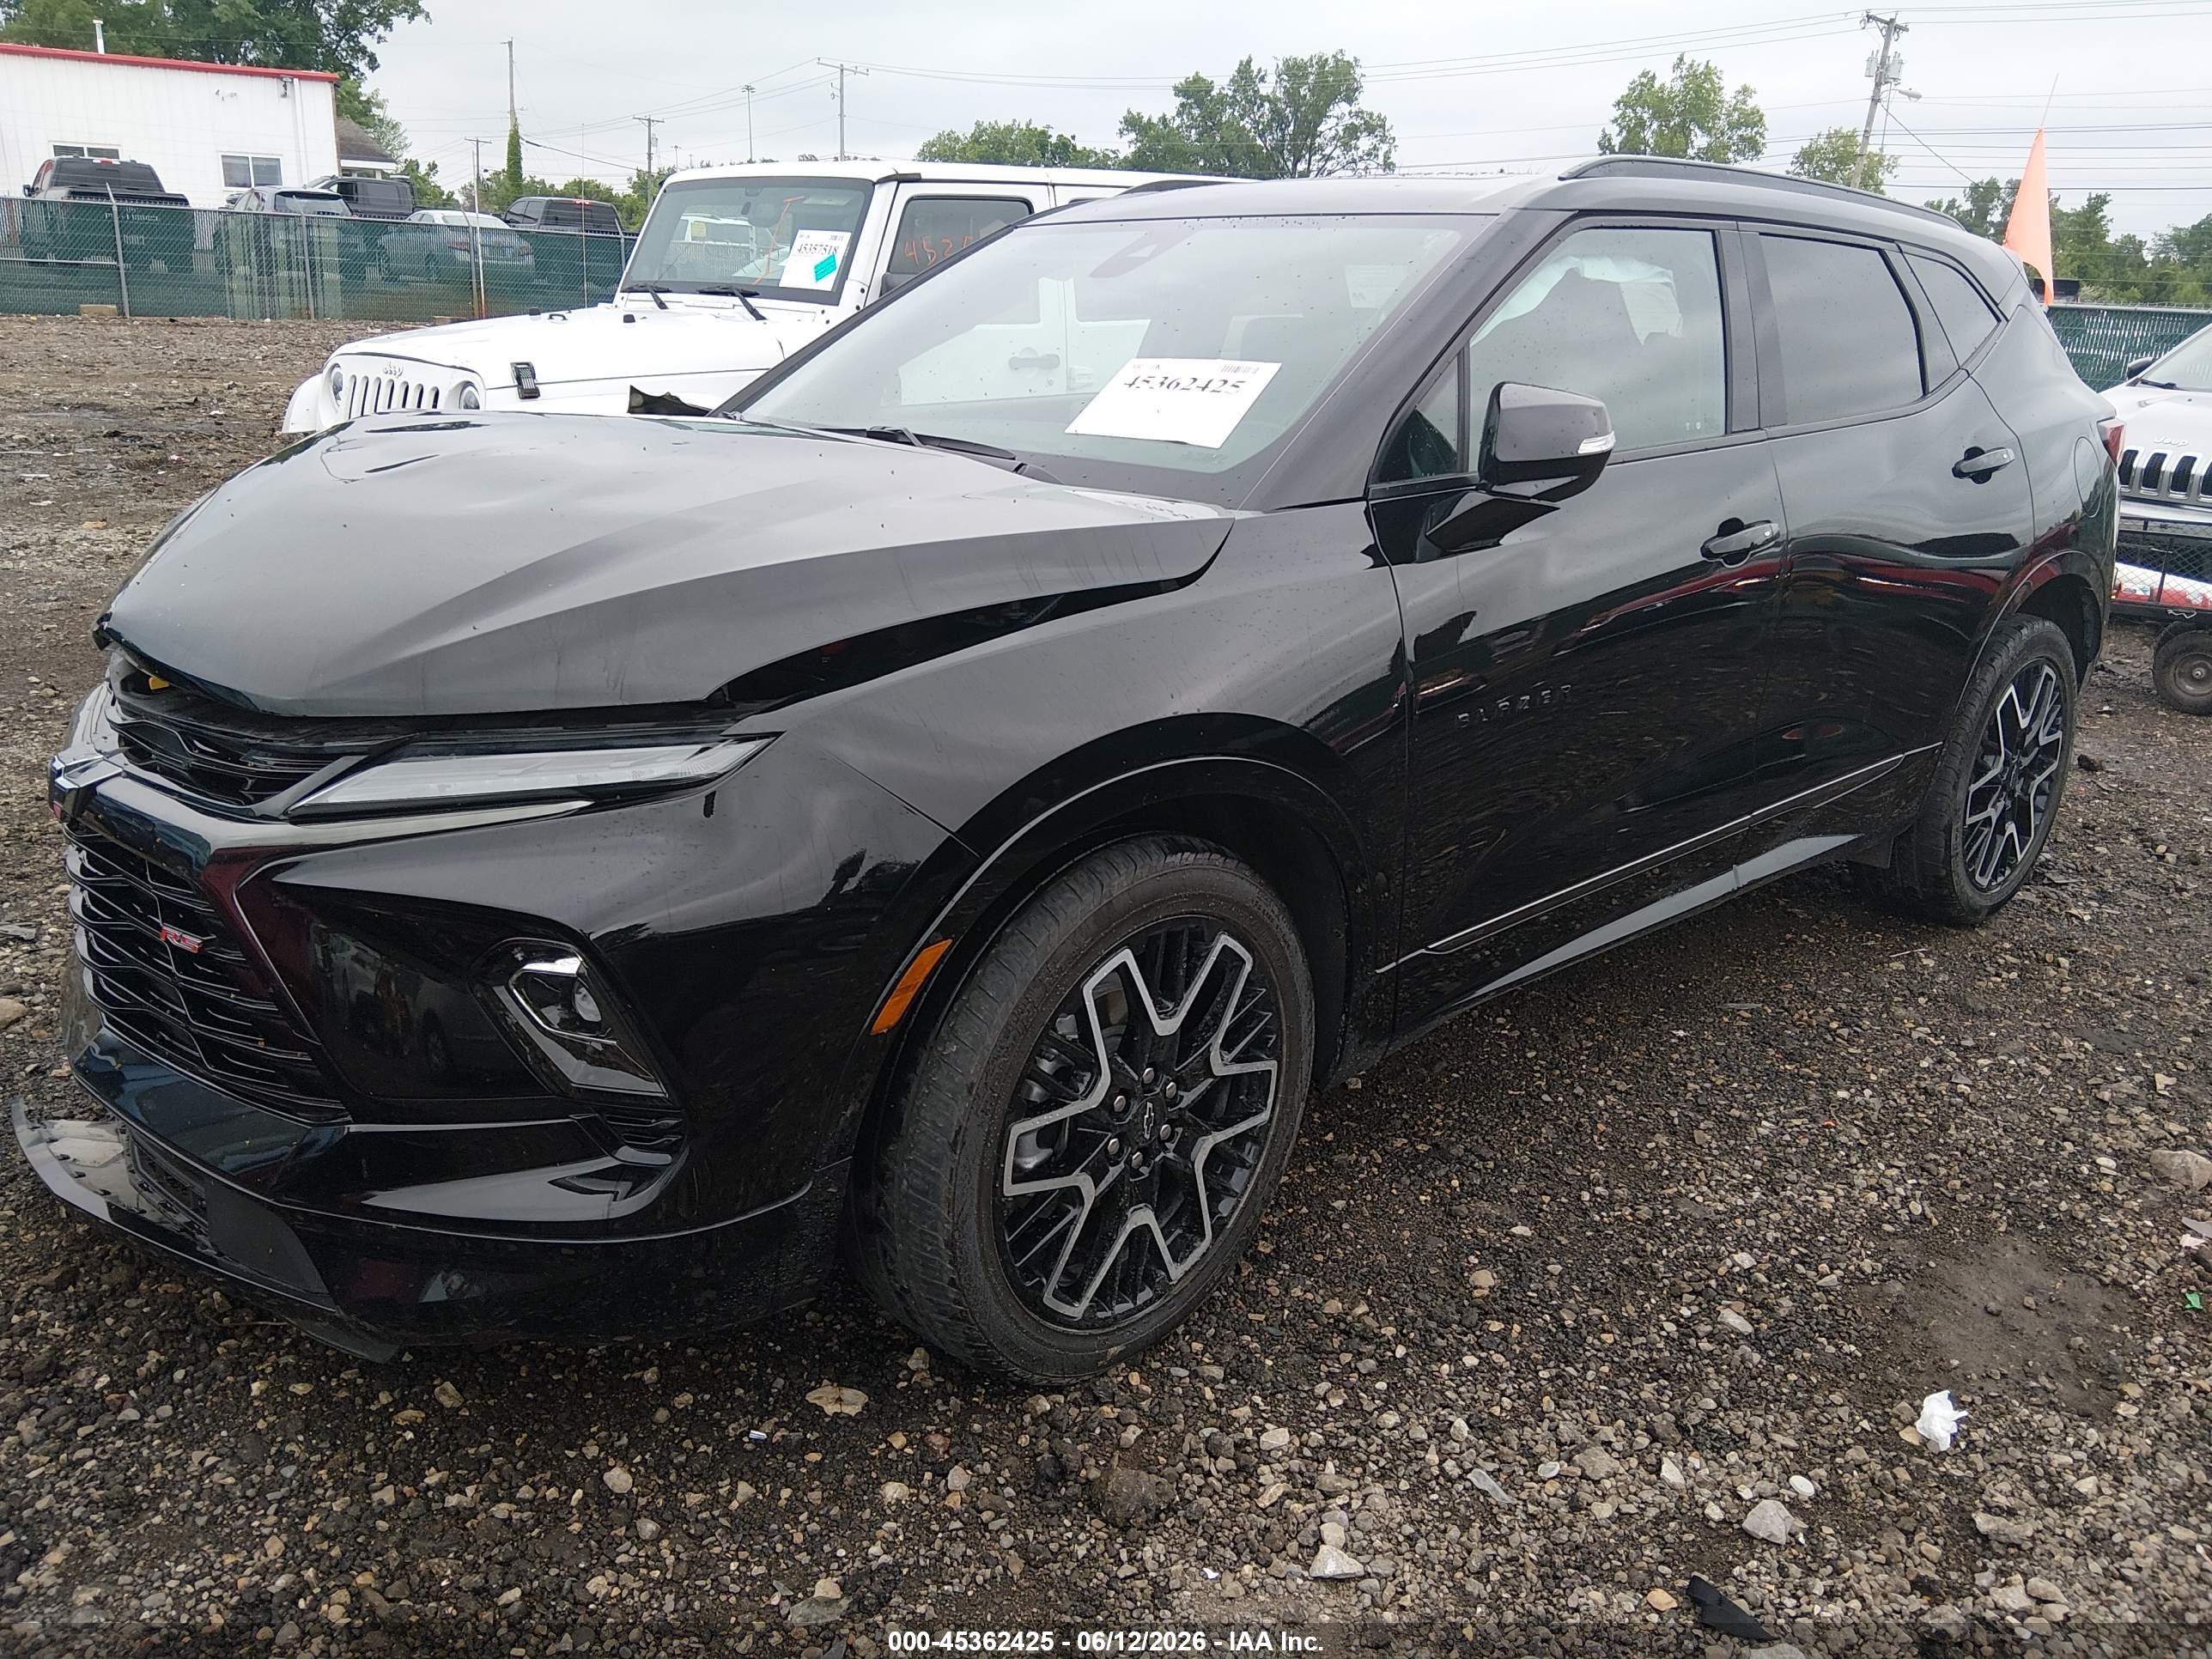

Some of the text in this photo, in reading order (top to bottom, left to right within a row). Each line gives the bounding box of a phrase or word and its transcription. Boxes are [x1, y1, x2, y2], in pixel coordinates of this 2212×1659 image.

[1124, 374, 1247, 394] 45362425
[2154, 435, 2190, 447] Jeep
[159, 923, 206, 953] RS
